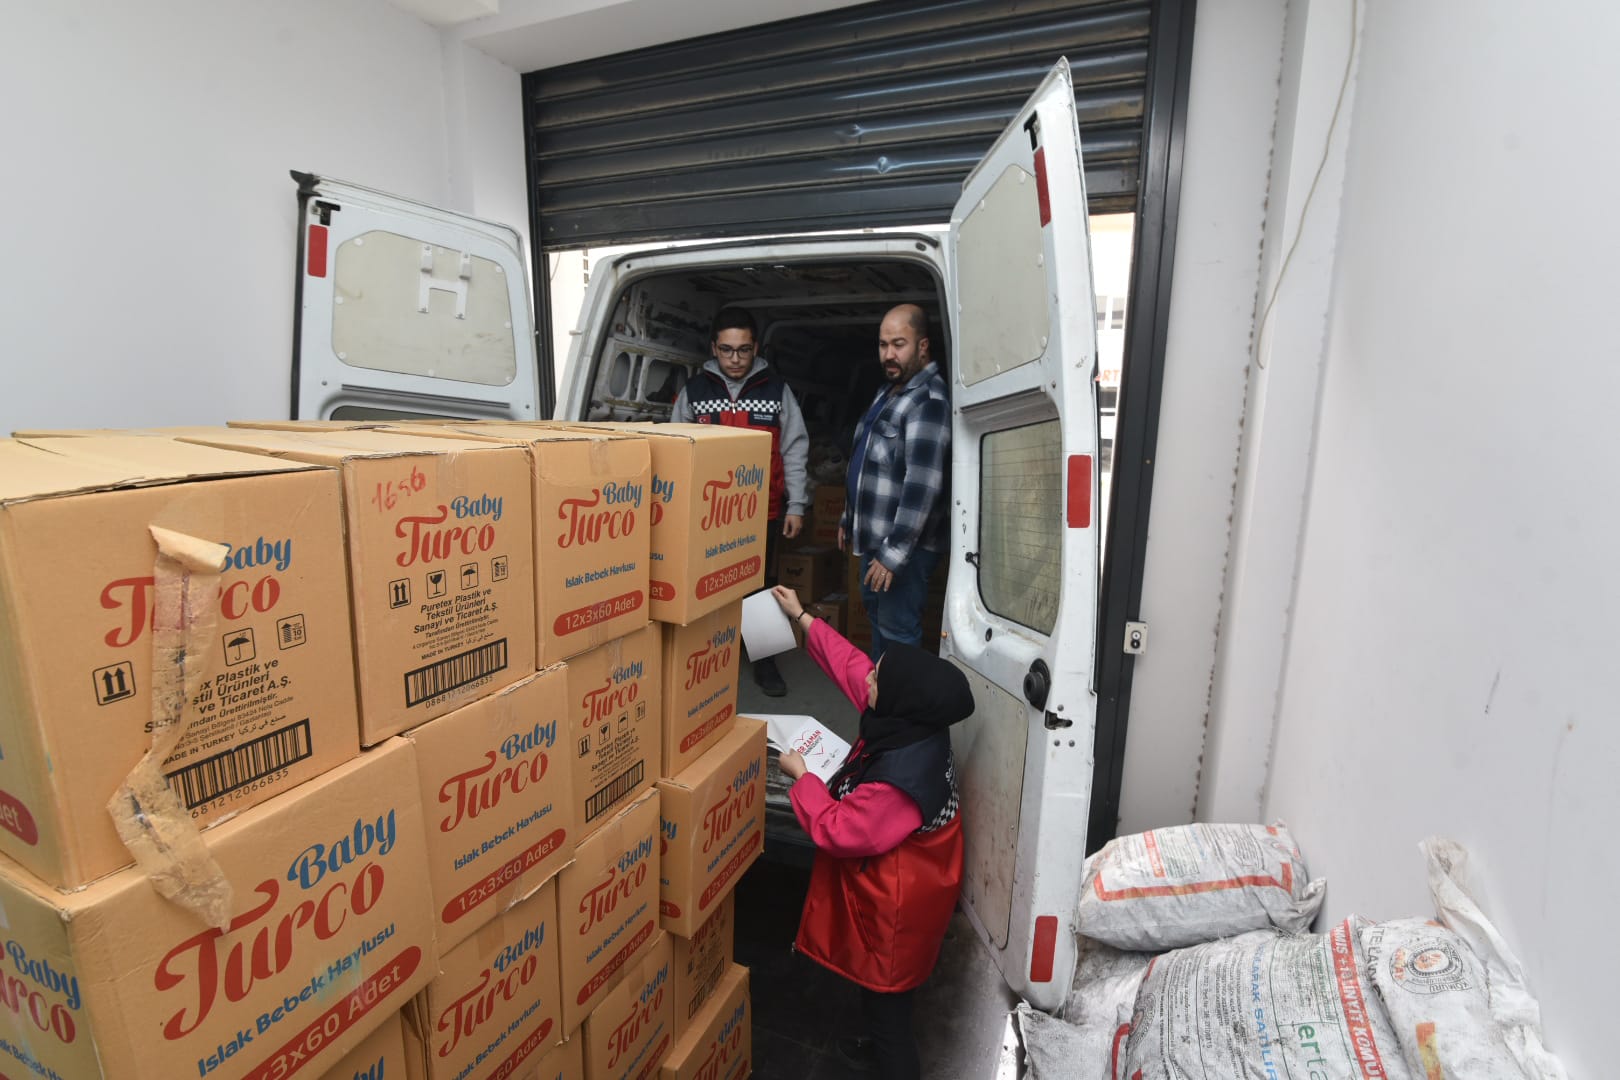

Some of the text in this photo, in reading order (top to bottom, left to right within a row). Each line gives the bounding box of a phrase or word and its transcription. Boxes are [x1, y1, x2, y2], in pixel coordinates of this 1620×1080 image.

[602, 481, 642, 508] Baby
[651, 474, 674, 503] by
[735, 464, 764, 491] Baby
[451, 493, 503, 521] Baby
[558, 488, 635, 548] Turco
[701, 470, 757, 531] Turco
[395, 505, 495, 567] Turco
[565, 561, 636, 588] Islak Bebek Havlusu
[652, 586, 665, 598] et
[704, 562, 756, 593] 12x3x60 Adet
[414, 620, 443, 634] Sanayi
[456, 607, 482, 621] Ticaret
[421, 588, 492, 613] Puretex Plastik ve
[426, 598, 486, 621] Tekstil Ürünleri
[566, 596, 636, 630] 12x3x60 Adet
[713, 624, 736, 648] Baby
[216, 663, 260, 687] Plastik
[264, 659, 279, 669] ve
[613, 659, 643, 684] Baby
[685, 639, 731, 691] Turco
[192, 690, 212, 706] stil
[217, 671, 270, 697] Ürünleri
[200, 704, 215, 714] ve
[220, 686, 264, 707] Ticaret
[582, 677, 638, 728] Turco
[189, 748, 199, 756] IN
[202, 732, 235, 751] TURKEY
[500, 719, 557, 760] Baby
[192, 768, 290, 820] 681212066835
[438, 750, 549, 833] Turco
[733, 756, 761, 793] Baby
[2, 805, 23, 833] et
[454, 803, 553, 871] Islak Bebek Havlusu
[660, 815, 677, 840] by
[702, 783, 755, 854] Turco
[287, 808, 396, 890] Baby
[618, 833, 653, 873] Baby
[458, 838, 555, 911] 12x3x60 Adet
[579, 862, 646, 935] Turco
[154, 862, 384, 1040] Turco
[494, 921, 544, 973] Baby
[6, 940, 81, 1010] Baby
[348, 964, 401, 1020] Adet
[640, 961, 668, 1003] Baby
[198, 922, 396, 1078] Islak Bebek Havlusu
[438, 955, 537, 1057] Turco
[516, 1029, 543, 1062] Adet
[608, 988, 663, 1069] Turco
